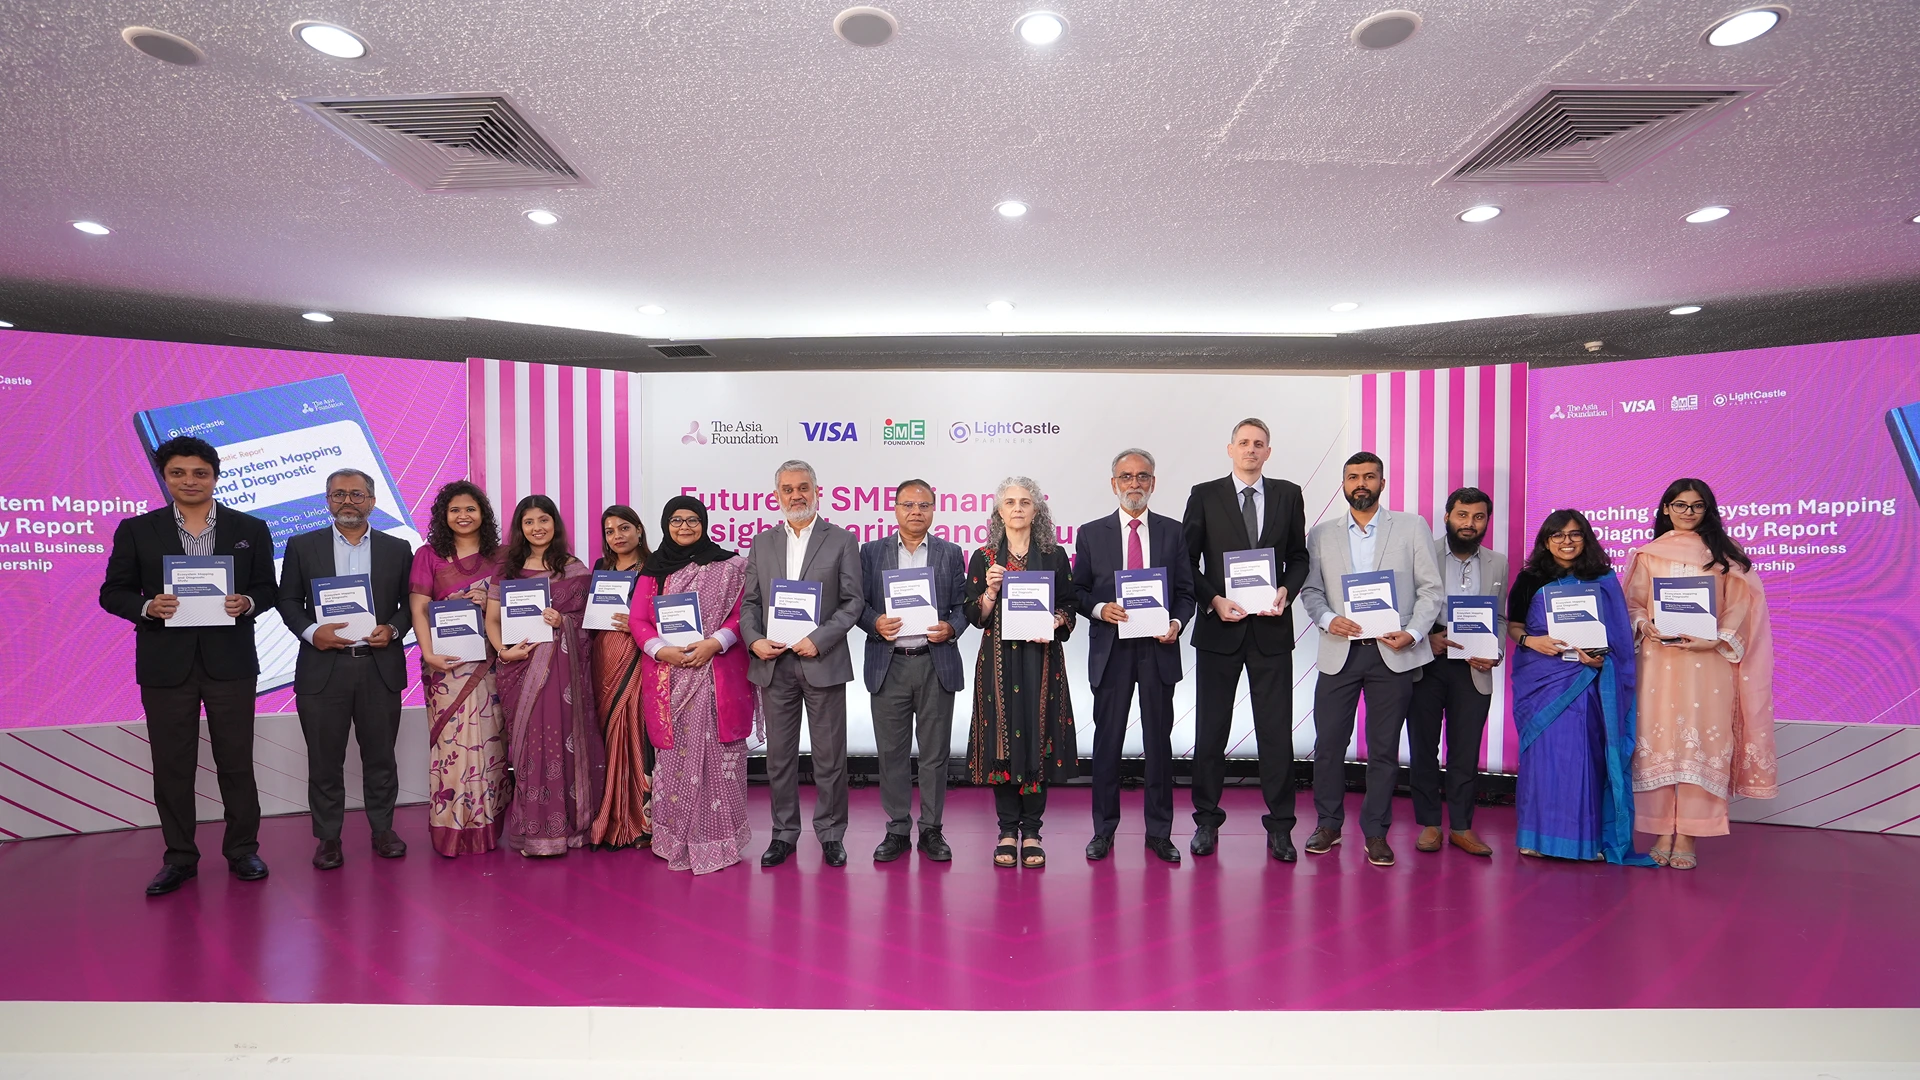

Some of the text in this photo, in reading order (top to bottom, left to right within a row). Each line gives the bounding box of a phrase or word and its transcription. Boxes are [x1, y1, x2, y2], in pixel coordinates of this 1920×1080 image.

[1729, 389, 1787, 402] LightCastle
[1567, 403, 1598, 412] The Asia
[1619, 399, 1656, 413] VISA
[1567, 410, 1608, 419] Foundation
[180, 419, 225, 434] LightCastle
[711, 421, 762, 432] The Asia
[799, 421, 858, 442] VISA
[975, 421, 1060, 437] LightCastle
[711, 433, 778, 445] Foundation
[239, 447, 265, 458] Report
[219, 445, 342, 480] osystem Mapping
[213, 463, 317, 496] and Diagnostic
[52, 495, 149, 516] Mapping
[831, 486, 898, 511] SME
[1717, 502, 1791, 520] system
[1798, 497, 1896, 517] Mapping
[281, 514, 302, 525] Gap:
[295, 520, 326, 532] Finance
[16, 517, 95, 538] Report
[934, 518, 993, 543] and
[1764, 521, 1838, 540] Report
[35, 542, 105, 554] Business
[1779, 543, 1847, 555] Business
[0, 559, 53, 573] ership
